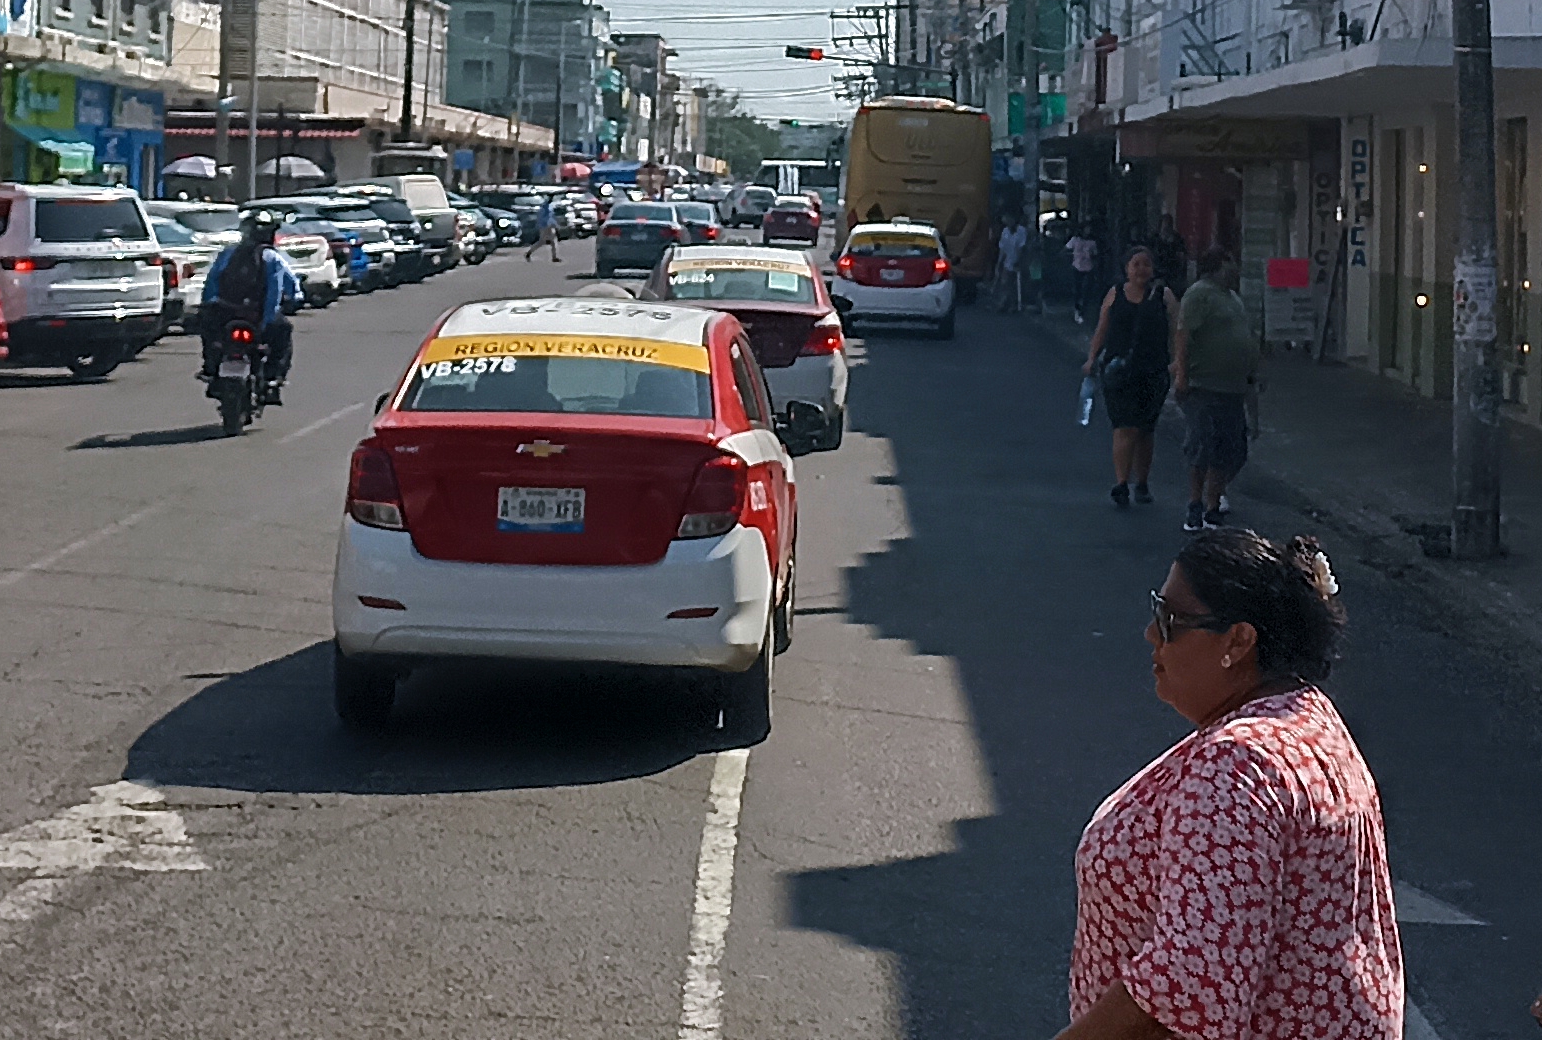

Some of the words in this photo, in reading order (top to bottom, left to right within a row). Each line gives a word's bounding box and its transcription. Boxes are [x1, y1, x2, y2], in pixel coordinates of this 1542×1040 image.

[1314, 172, 1332, 284] OPTICA
[1351, 139, 1367, 267] OPTICA
[420, 356, 517, 380] VB-2578
[454, 340, 536, 356] REGION
[543, 340, 659, 360] VERACRUZ
